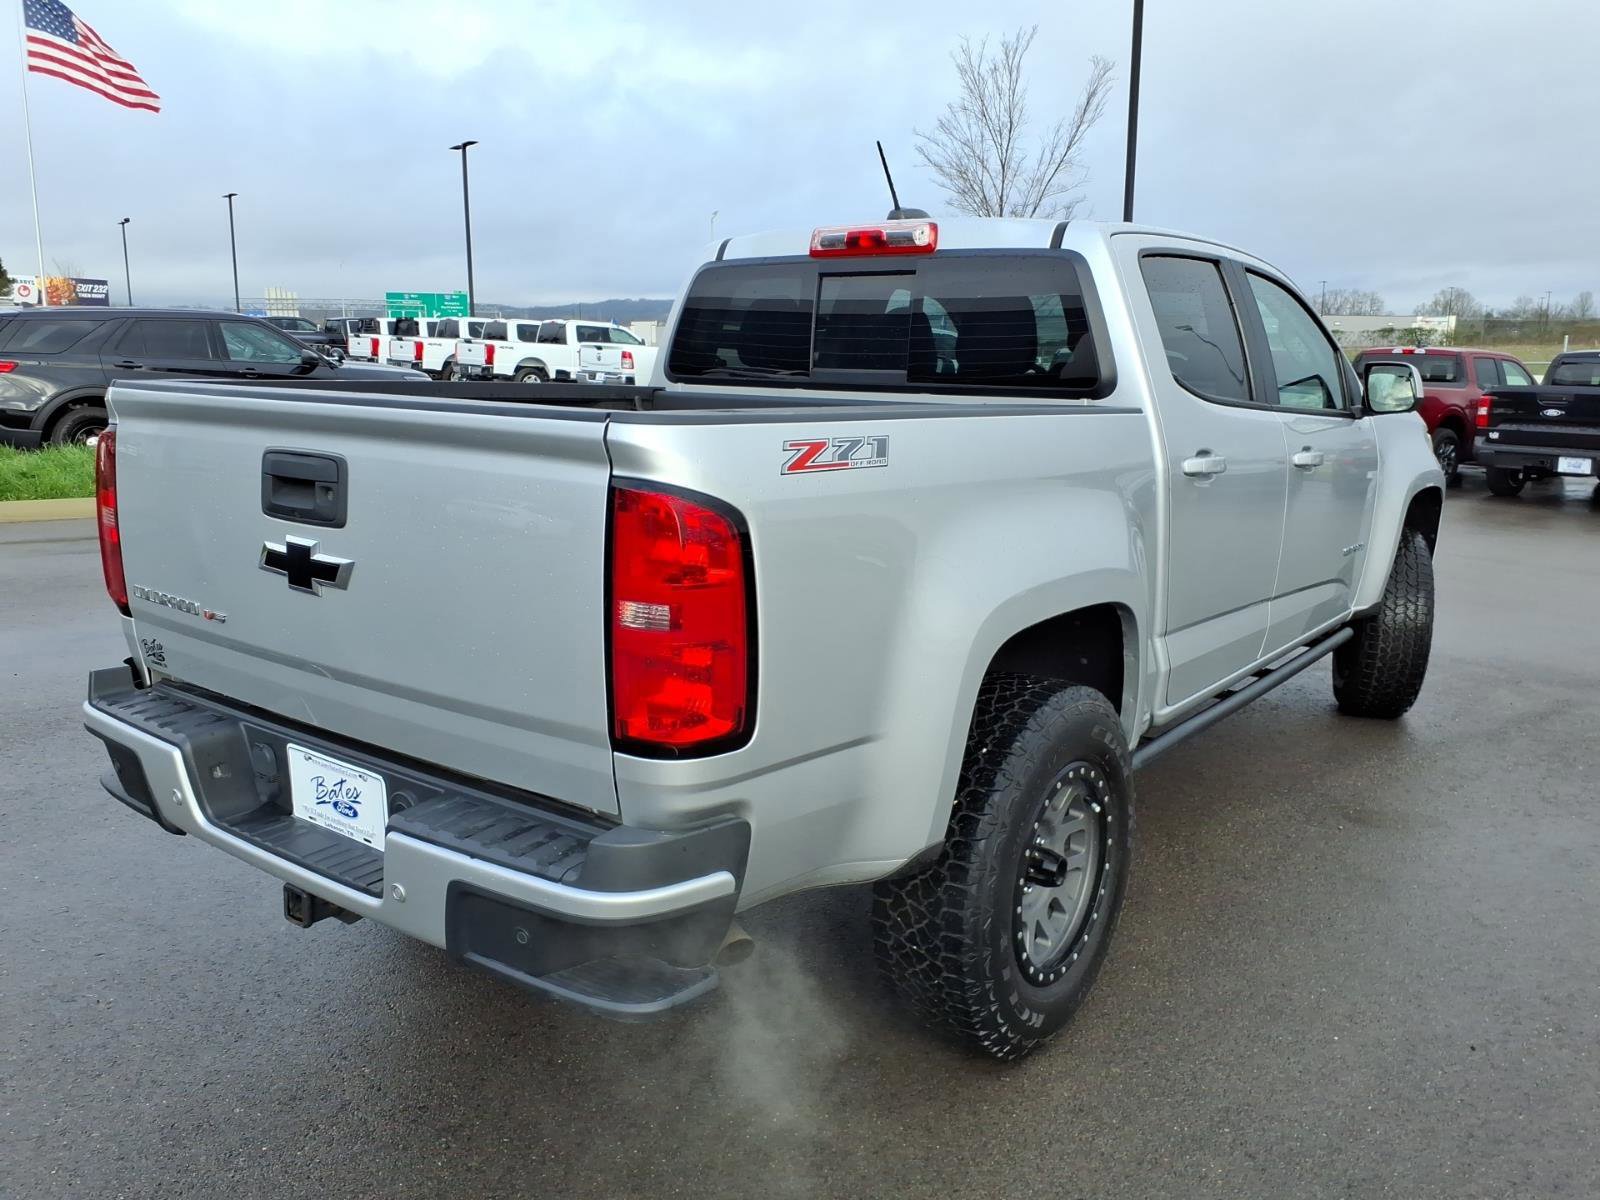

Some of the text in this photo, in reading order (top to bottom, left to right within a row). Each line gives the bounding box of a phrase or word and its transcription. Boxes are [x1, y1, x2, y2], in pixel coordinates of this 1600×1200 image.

[76, 283, 108, 293] EXIT 232
[780, 435, 889, 475] Z71
[311, 775, 362, 801] Bates
[336, 801, 355, 817] Ford
